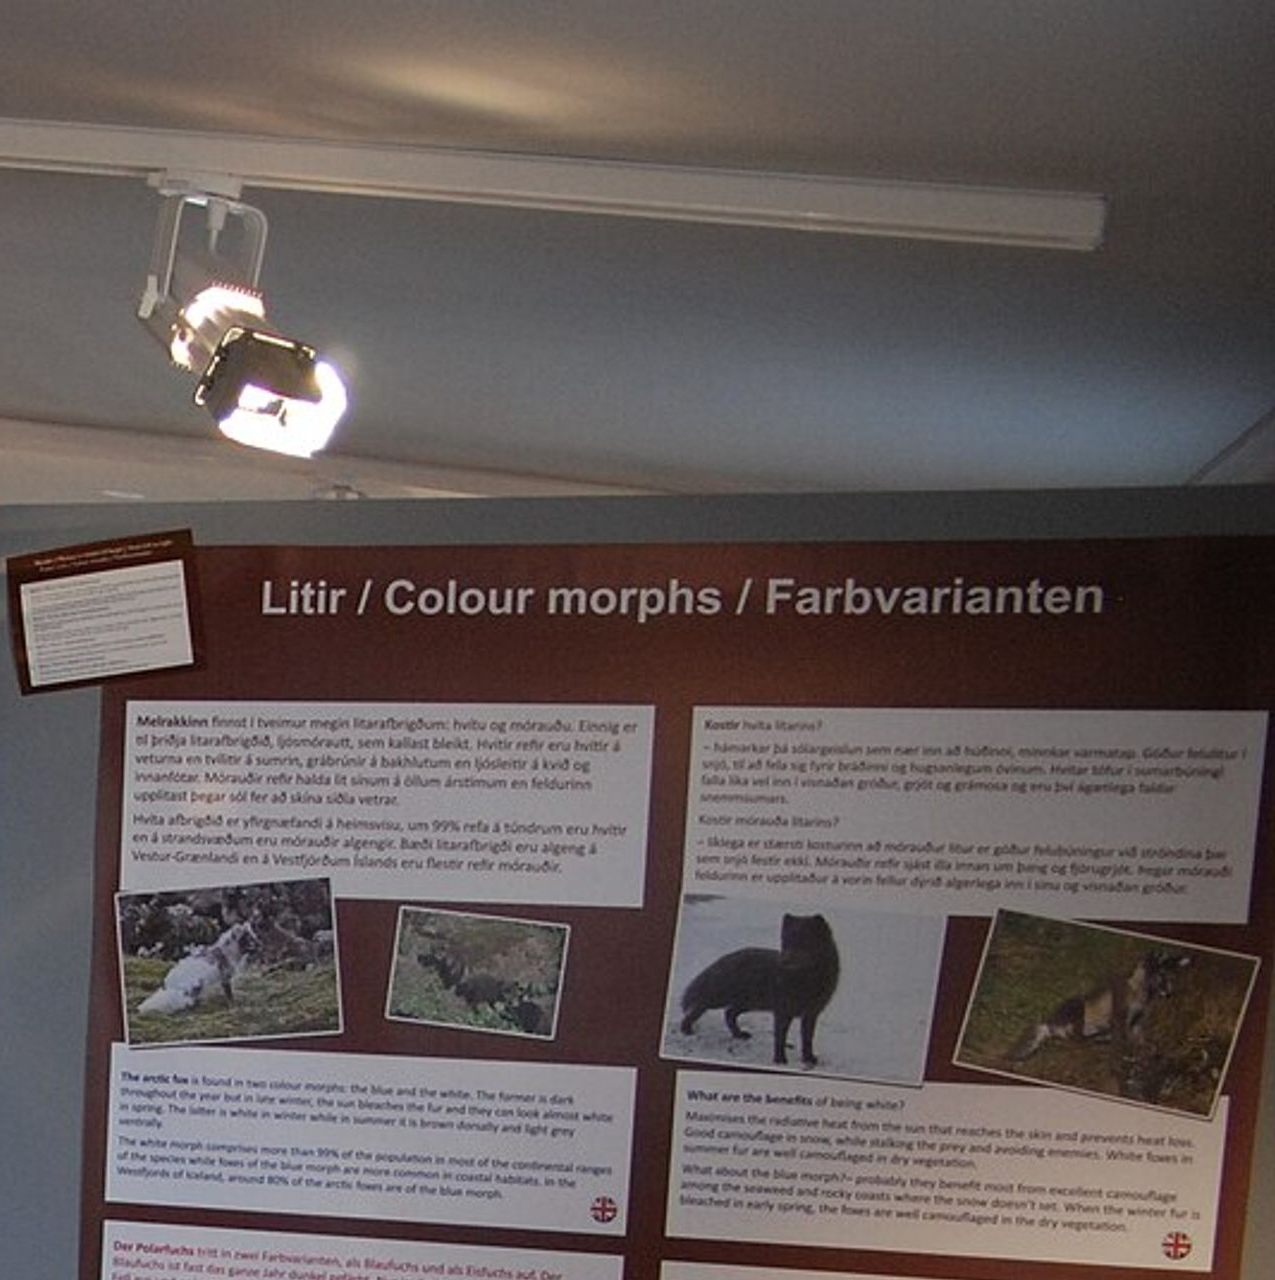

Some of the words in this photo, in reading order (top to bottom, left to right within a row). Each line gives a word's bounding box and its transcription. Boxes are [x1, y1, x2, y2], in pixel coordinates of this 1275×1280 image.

[262, 579, 347, 613] Litir
[357, 579, 371, 614] /
[385, 579, 534, 614] Colour
[548, 578, 720, 622] morphs
[736, 578, 751, 614] /
[766, 578, 1105, 613] Farbvarianten
